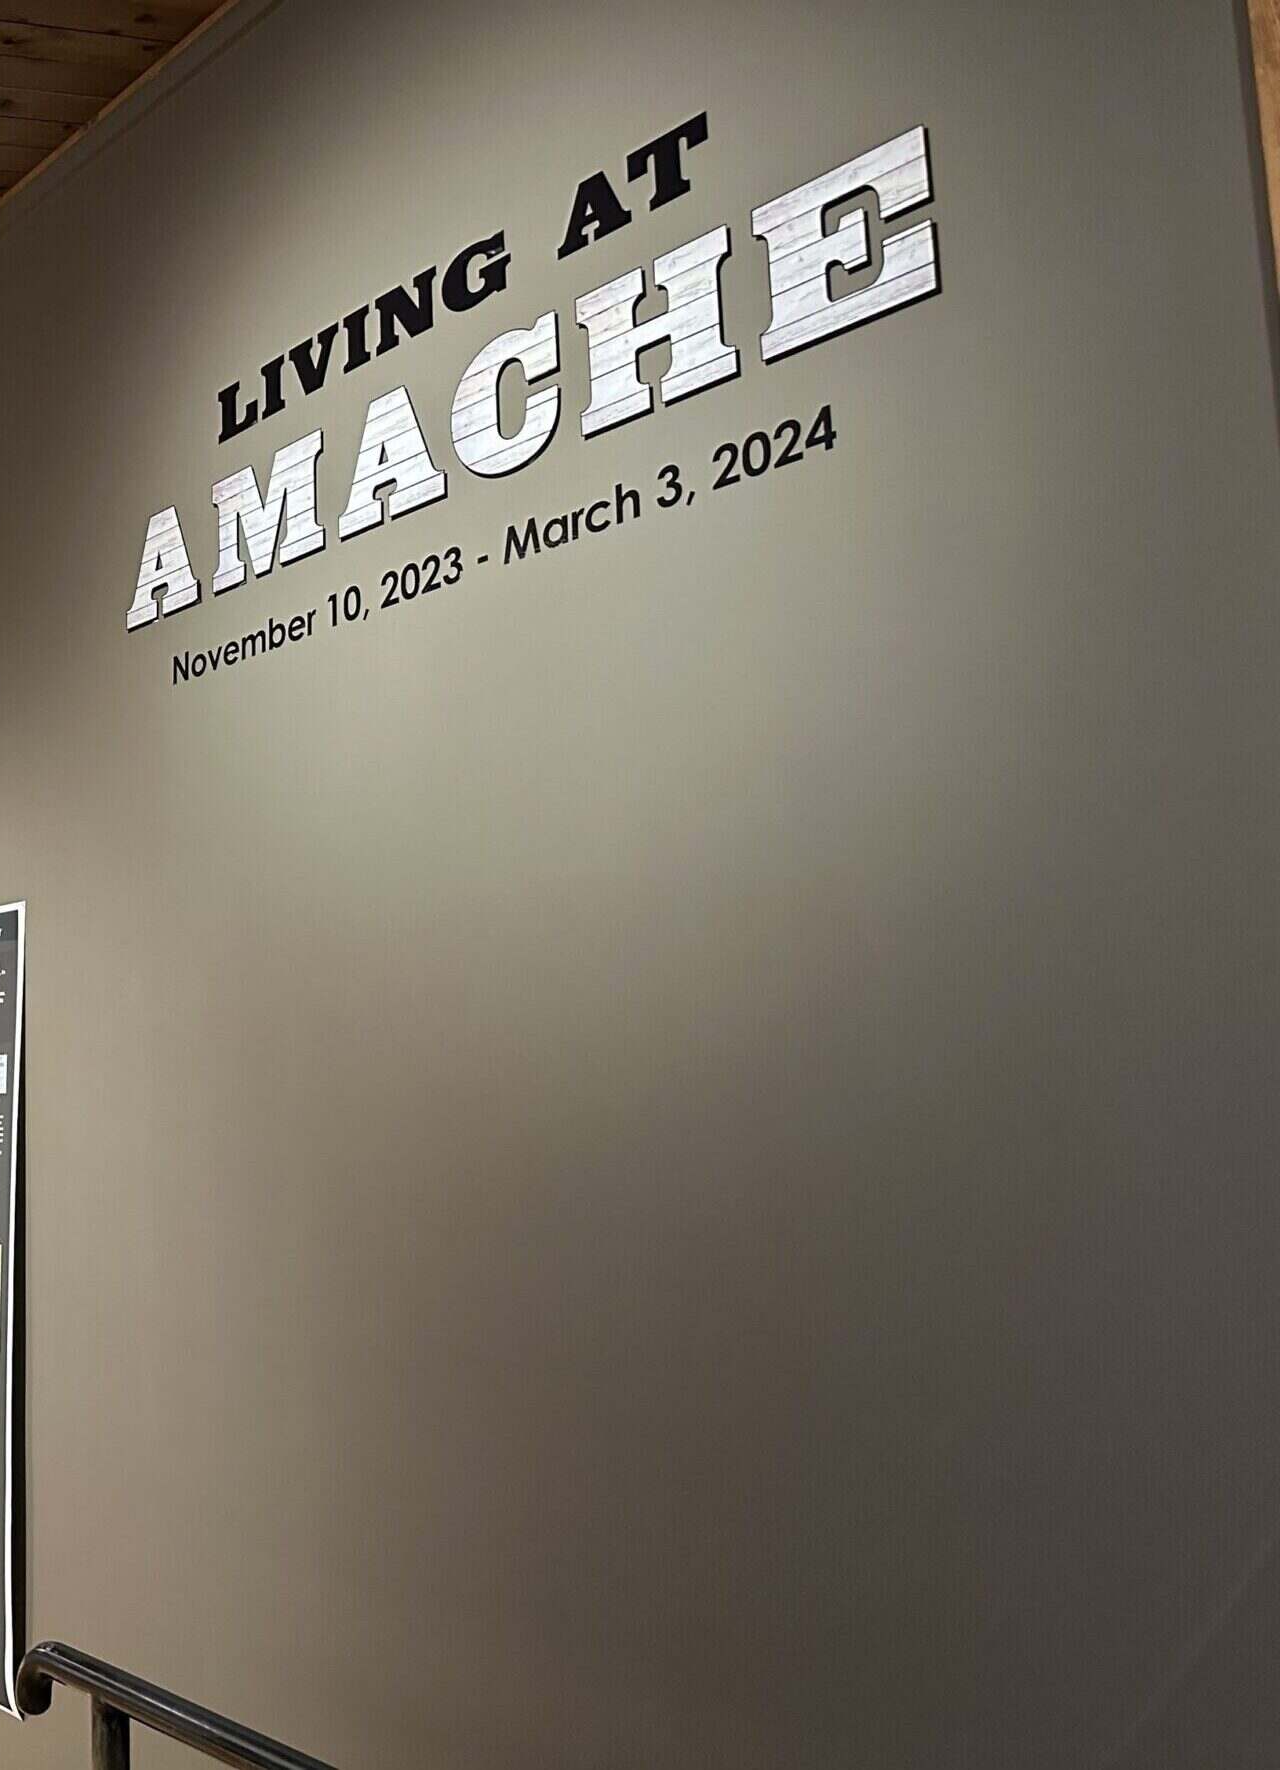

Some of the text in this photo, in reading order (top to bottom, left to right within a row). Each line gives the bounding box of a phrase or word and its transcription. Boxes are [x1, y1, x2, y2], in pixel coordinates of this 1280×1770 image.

[125, 125, 942, 633] AMACHE
[217, 111, 709, 445] LIVING AT
[172, 607, 317, 685] November
[327, 585, 370, 627] 10,
[380, 546, 464, 609] 2023
[503, 483, 641, 565] March
[656, 464, 696, 508] 3,
[712, 404, 837, 491] 2024
